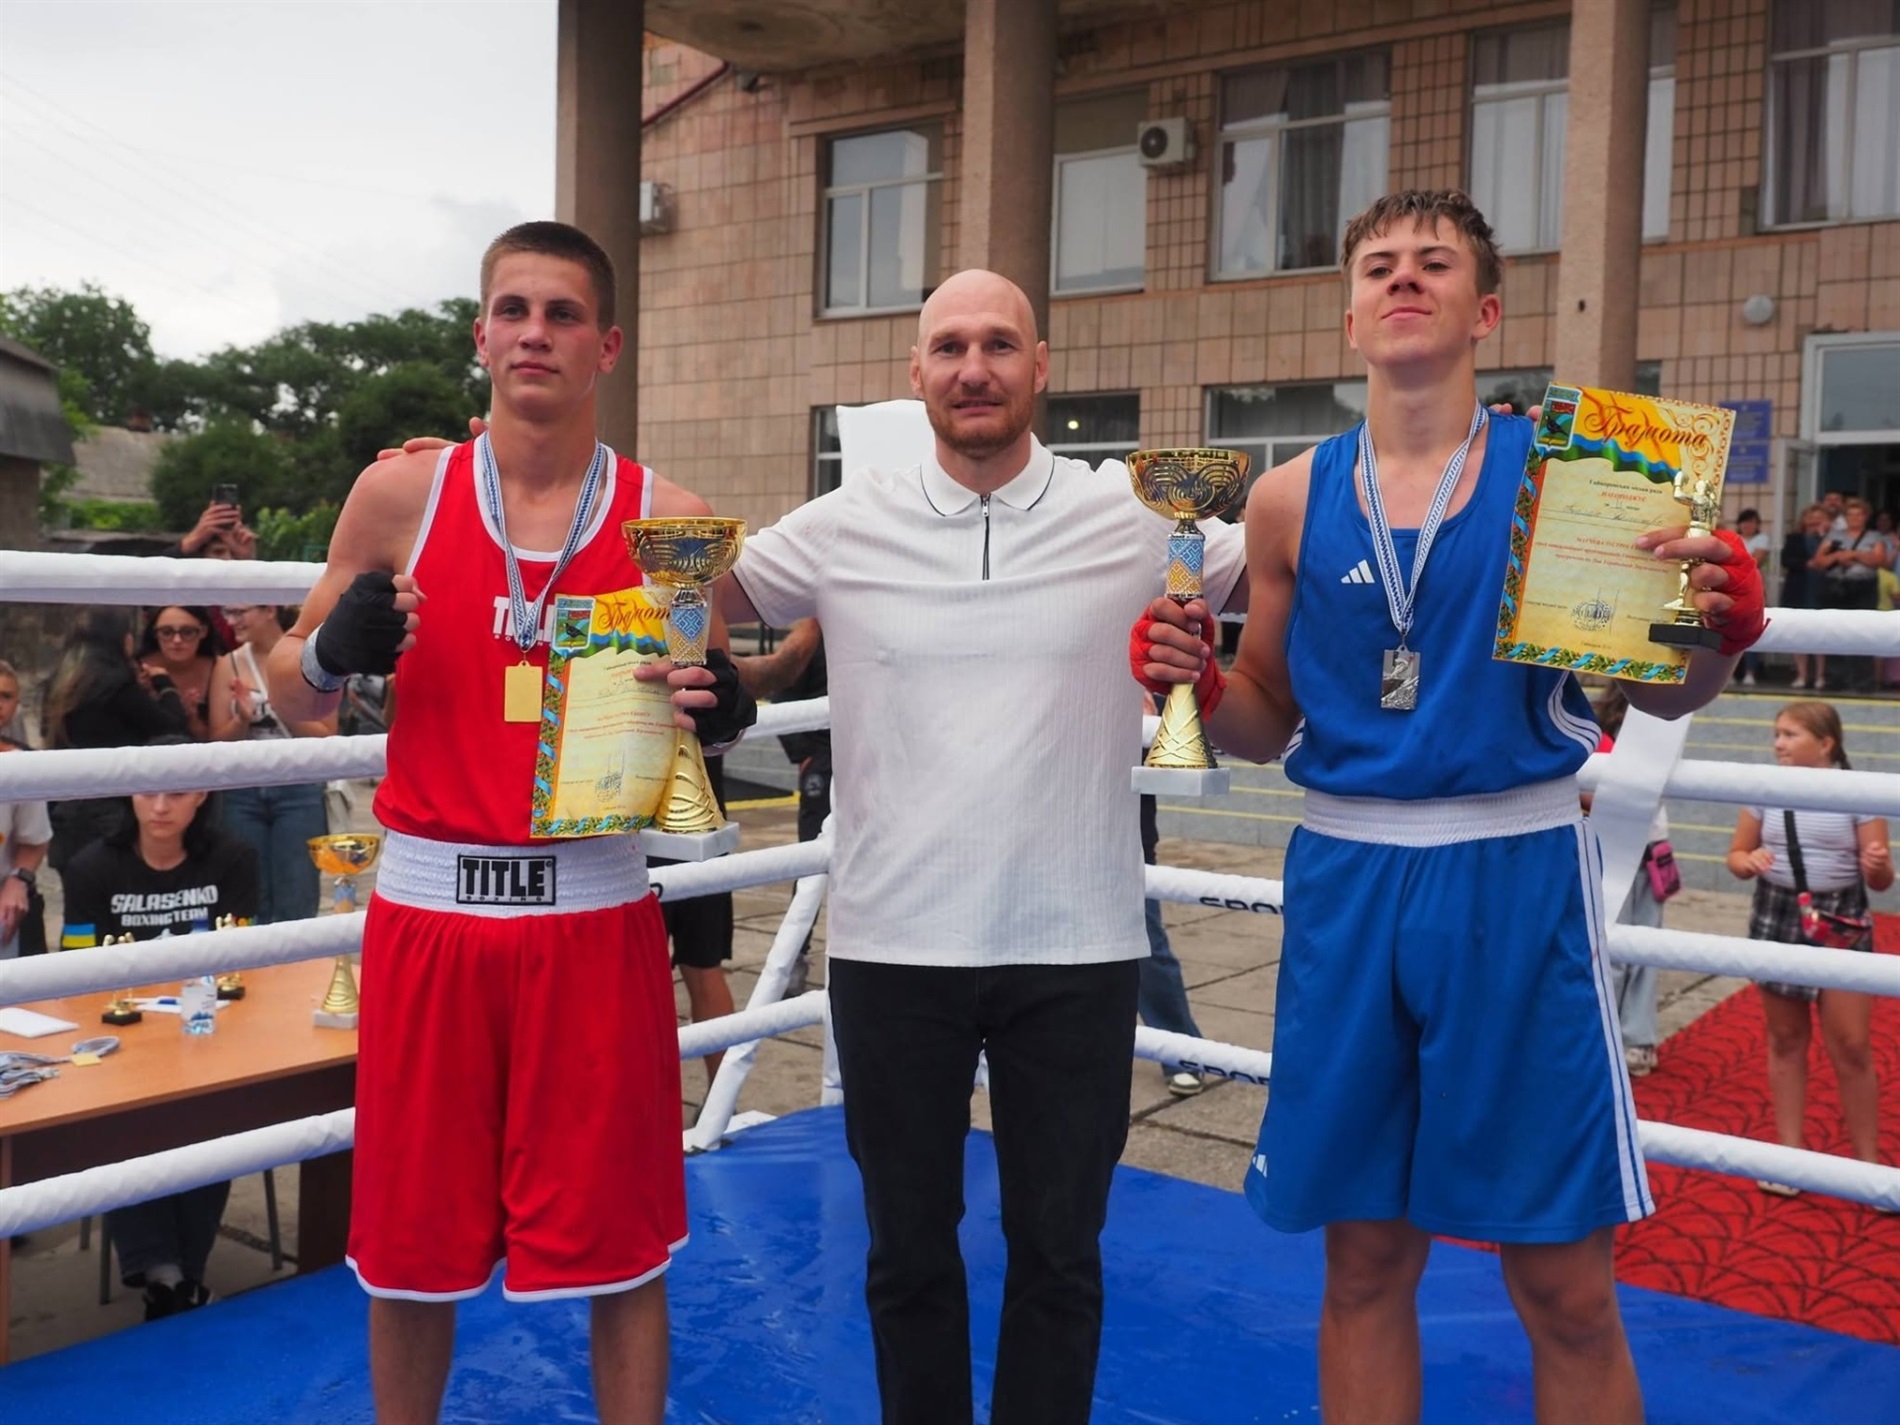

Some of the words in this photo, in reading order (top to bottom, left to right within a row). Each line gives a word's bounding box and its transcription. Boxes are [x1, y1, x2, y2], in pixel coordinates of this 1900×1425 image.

[1583, 403, 1708, 447] Грамота
[597, 601, 671, 633] Грамот
[462, 858, 546, 897] TITLE
[111, 884, 218, 914] SALASENKO
[121, 912, 172, 927] BOXING
[174, 907, 208, 923] TEAM
